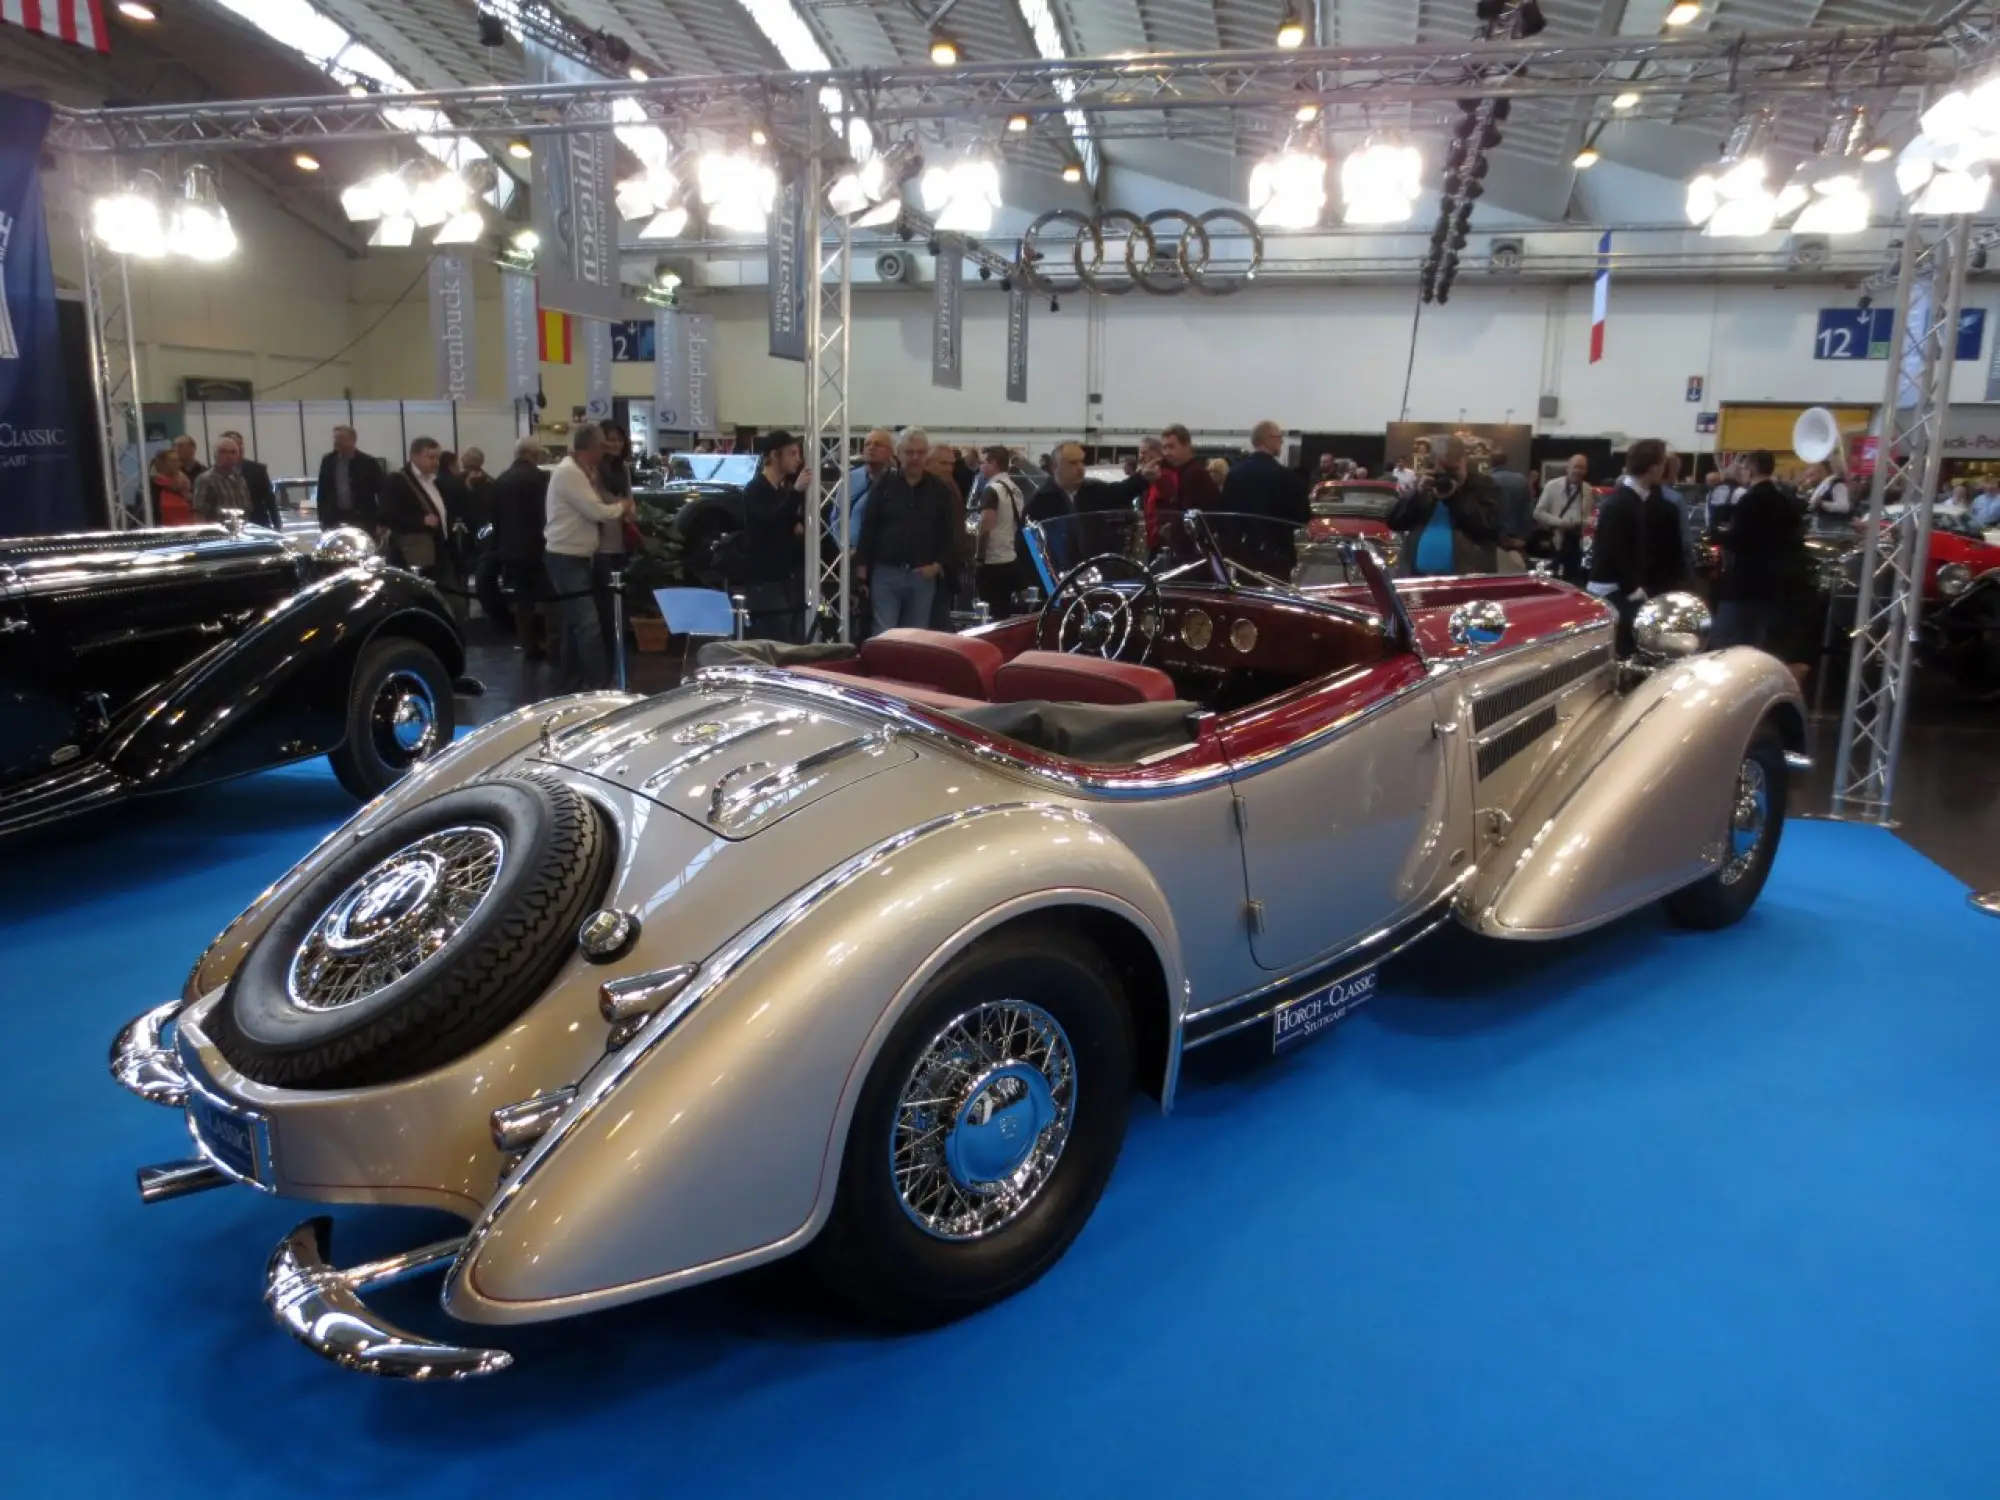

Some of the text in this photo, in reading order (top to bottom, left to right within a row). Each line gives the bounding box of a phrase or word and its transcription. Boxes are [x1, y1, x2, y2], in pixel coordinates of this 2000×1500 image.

[613, 335, 629, 361] 2
[1818, 327, 1852, 358] 12
[1303, 1006, 1347, 1036] STUTTGART
